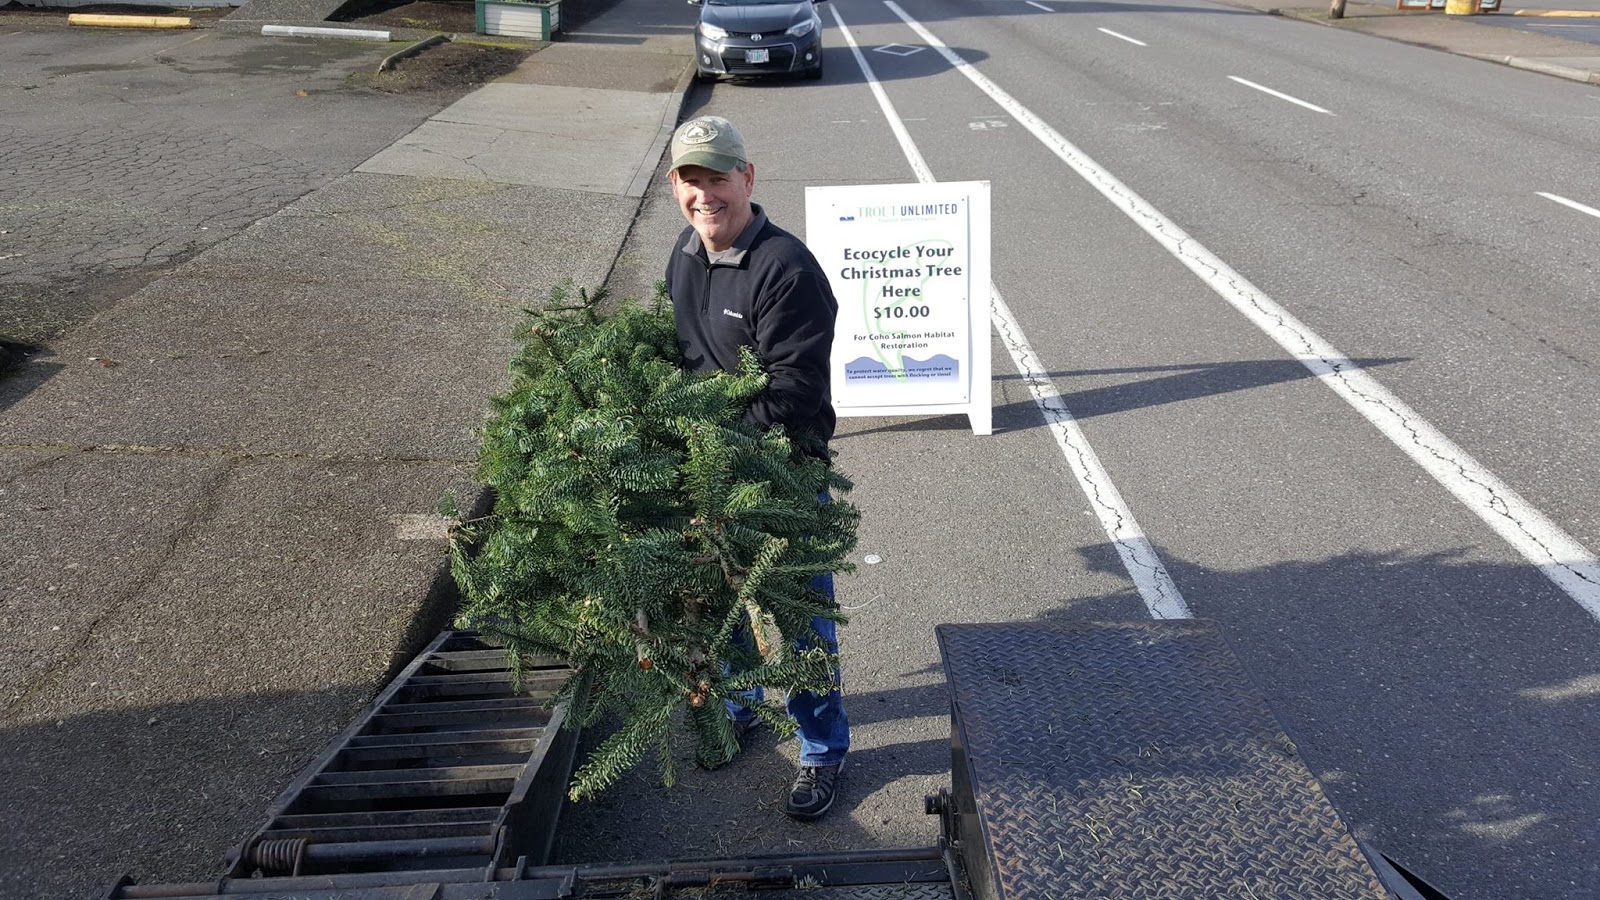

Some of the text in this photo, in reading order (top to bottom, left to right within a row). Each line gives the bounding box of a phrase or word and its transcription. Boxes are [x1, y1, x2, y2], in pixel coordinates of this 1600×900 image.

[858, 203, 958, 218] TROUT UNLIMITED
[844, 246, 954, 262] Ecocycle Your
[841, 264, 962, 279] Christmas Tree
[882, 286, 921, 297] Here
[874, 305, 930, 319] $10.00
